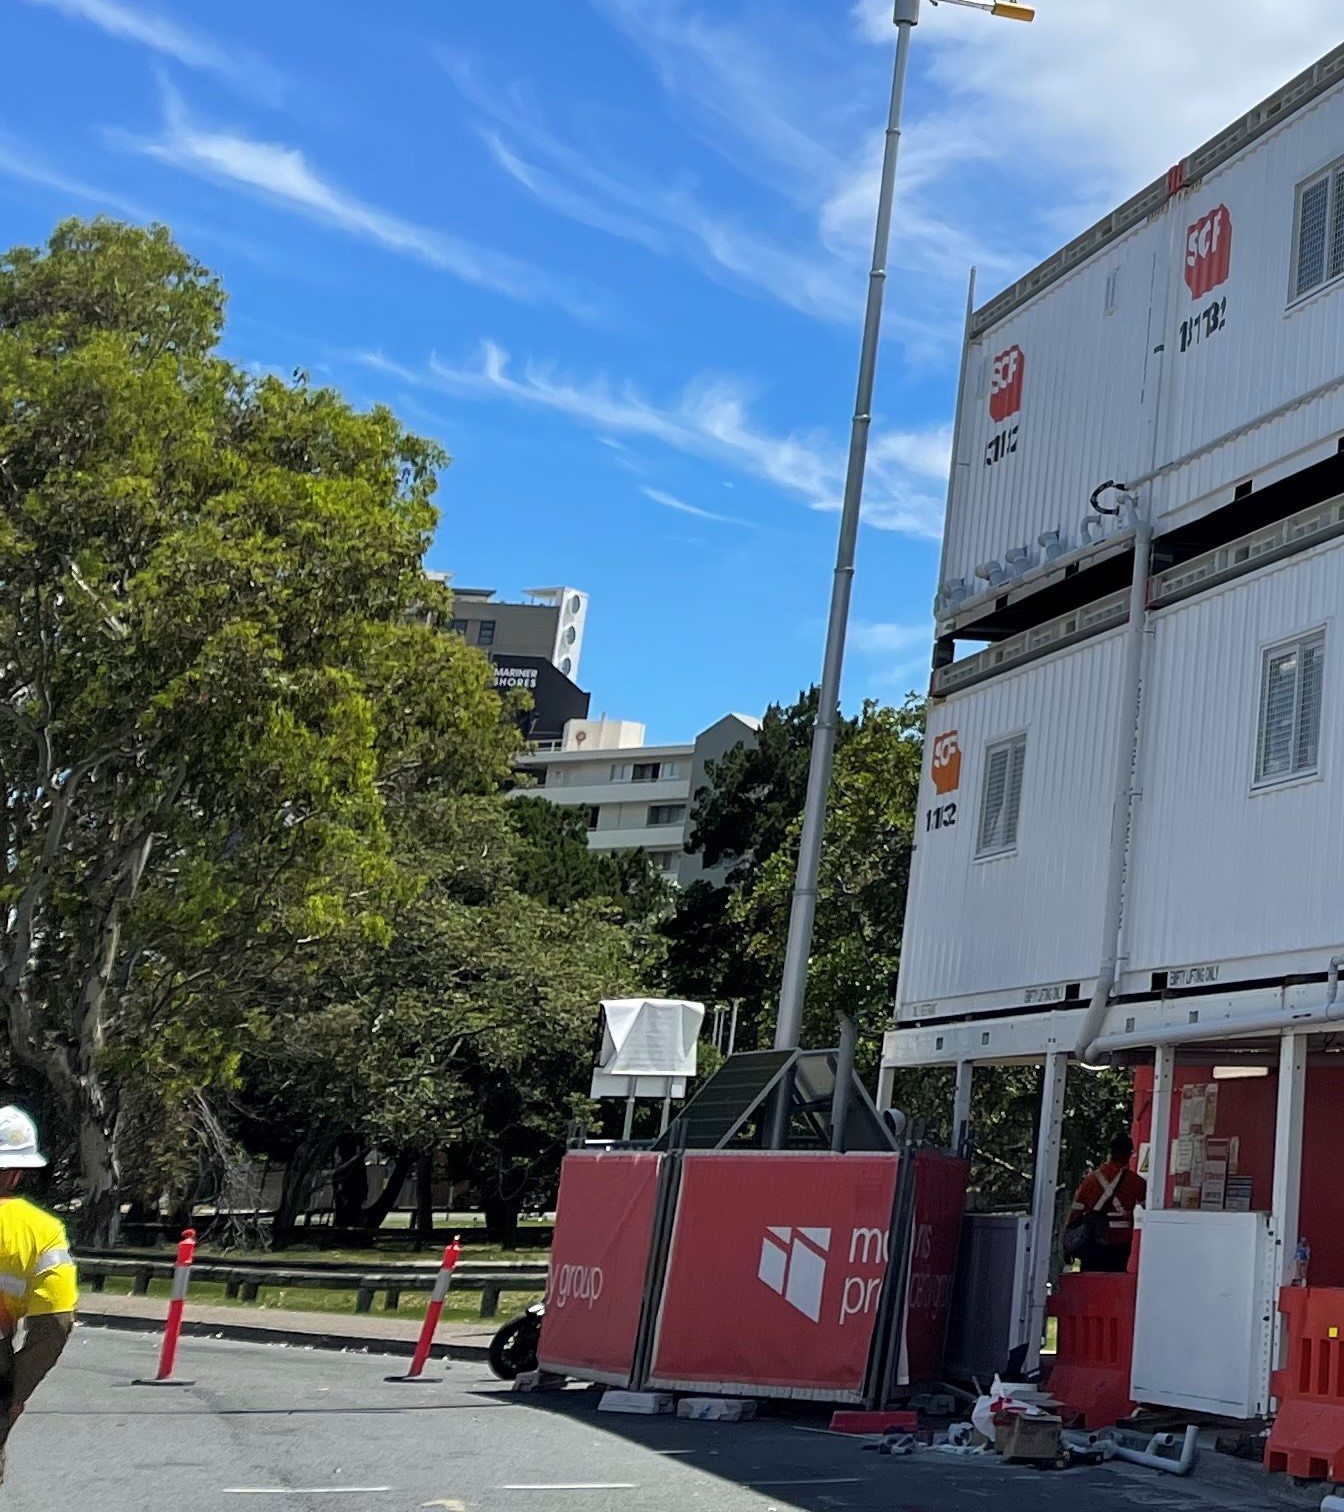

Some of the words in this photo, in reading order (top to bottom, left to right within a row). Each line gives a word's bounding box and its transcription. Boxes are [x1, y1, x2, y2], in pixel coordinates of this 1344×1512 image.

[1187, 211, 1223, 268] SCF
[991, 351, 1018, 395] SCF
[849, 1226, 890, 1264] m
[556, 1264, 603, 1310] group
[839, 1276, 883, 1326] pr
